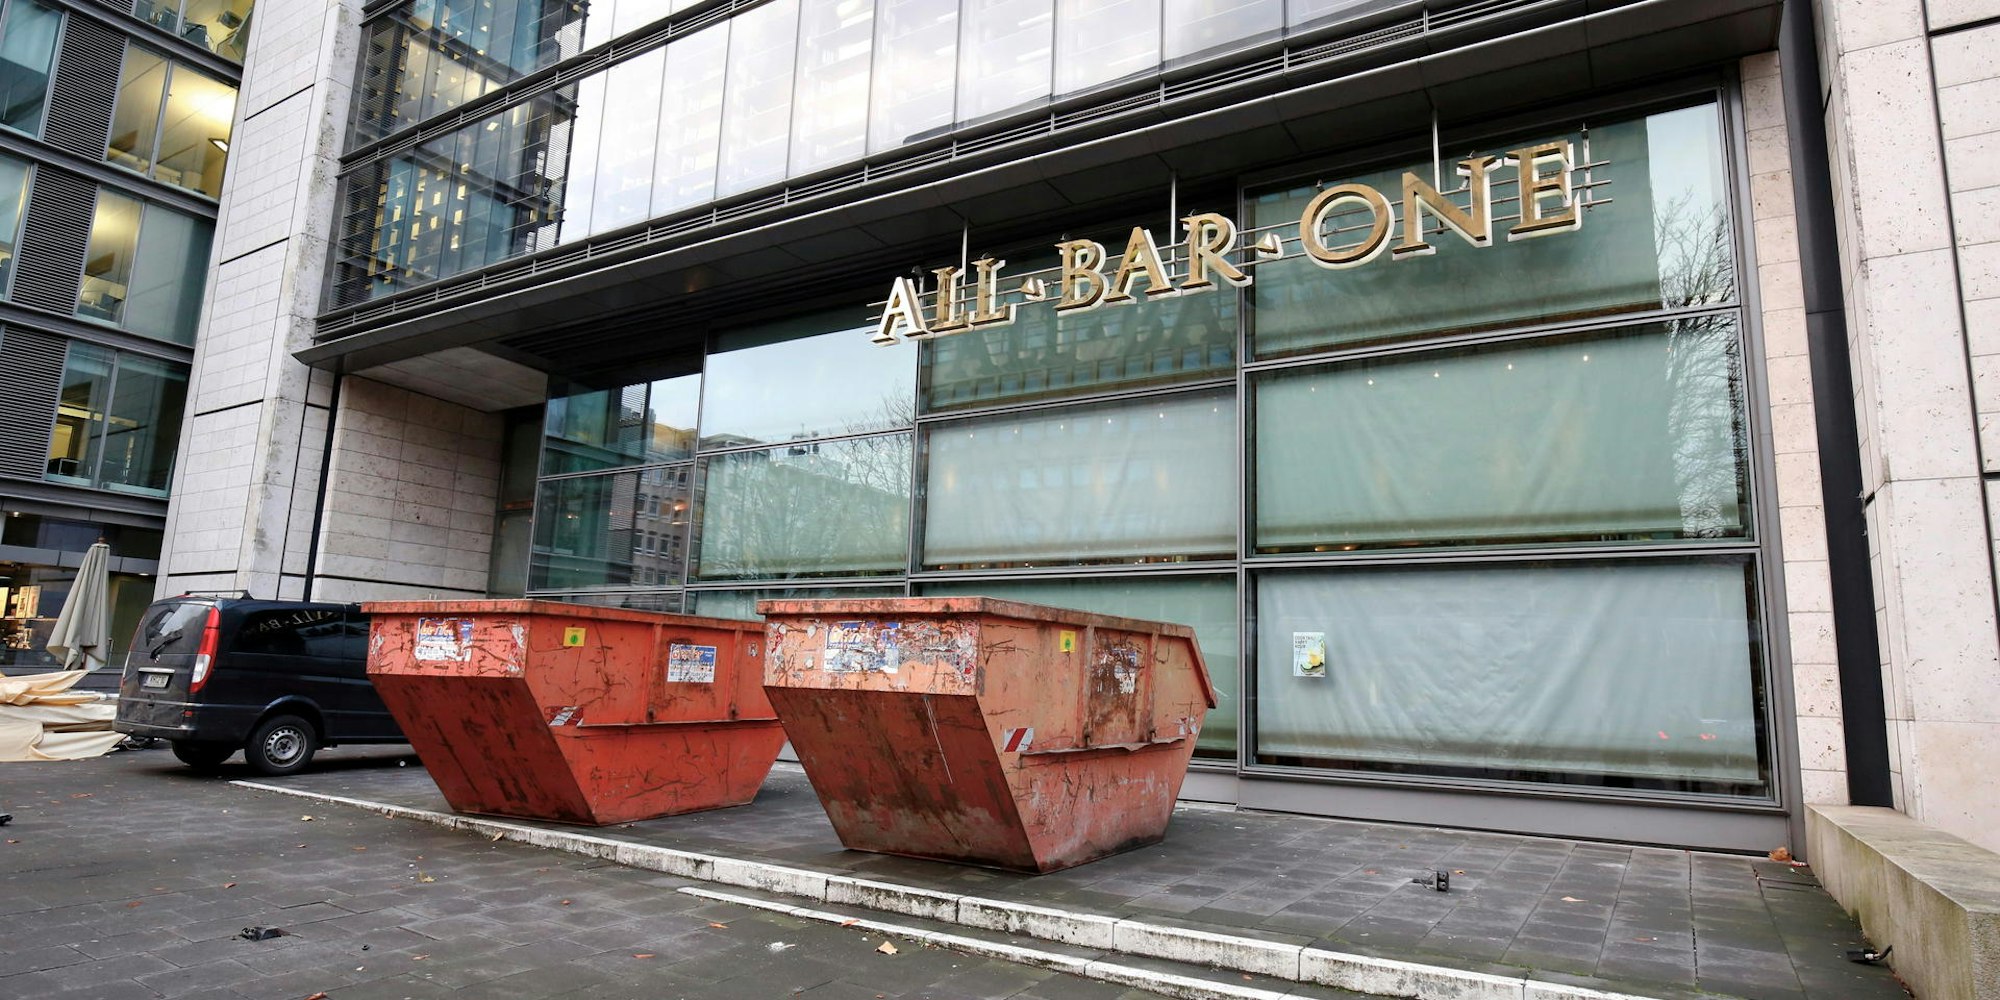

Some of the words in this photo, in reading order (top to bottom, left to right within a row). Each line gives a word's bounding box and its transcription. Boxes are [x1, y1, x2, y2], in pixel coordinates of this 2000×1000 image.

[872, 257, 1016, 345] ALL
[1054, 212, 1252, 316] BAR
[1301, 140, 1582, 270] ONE
